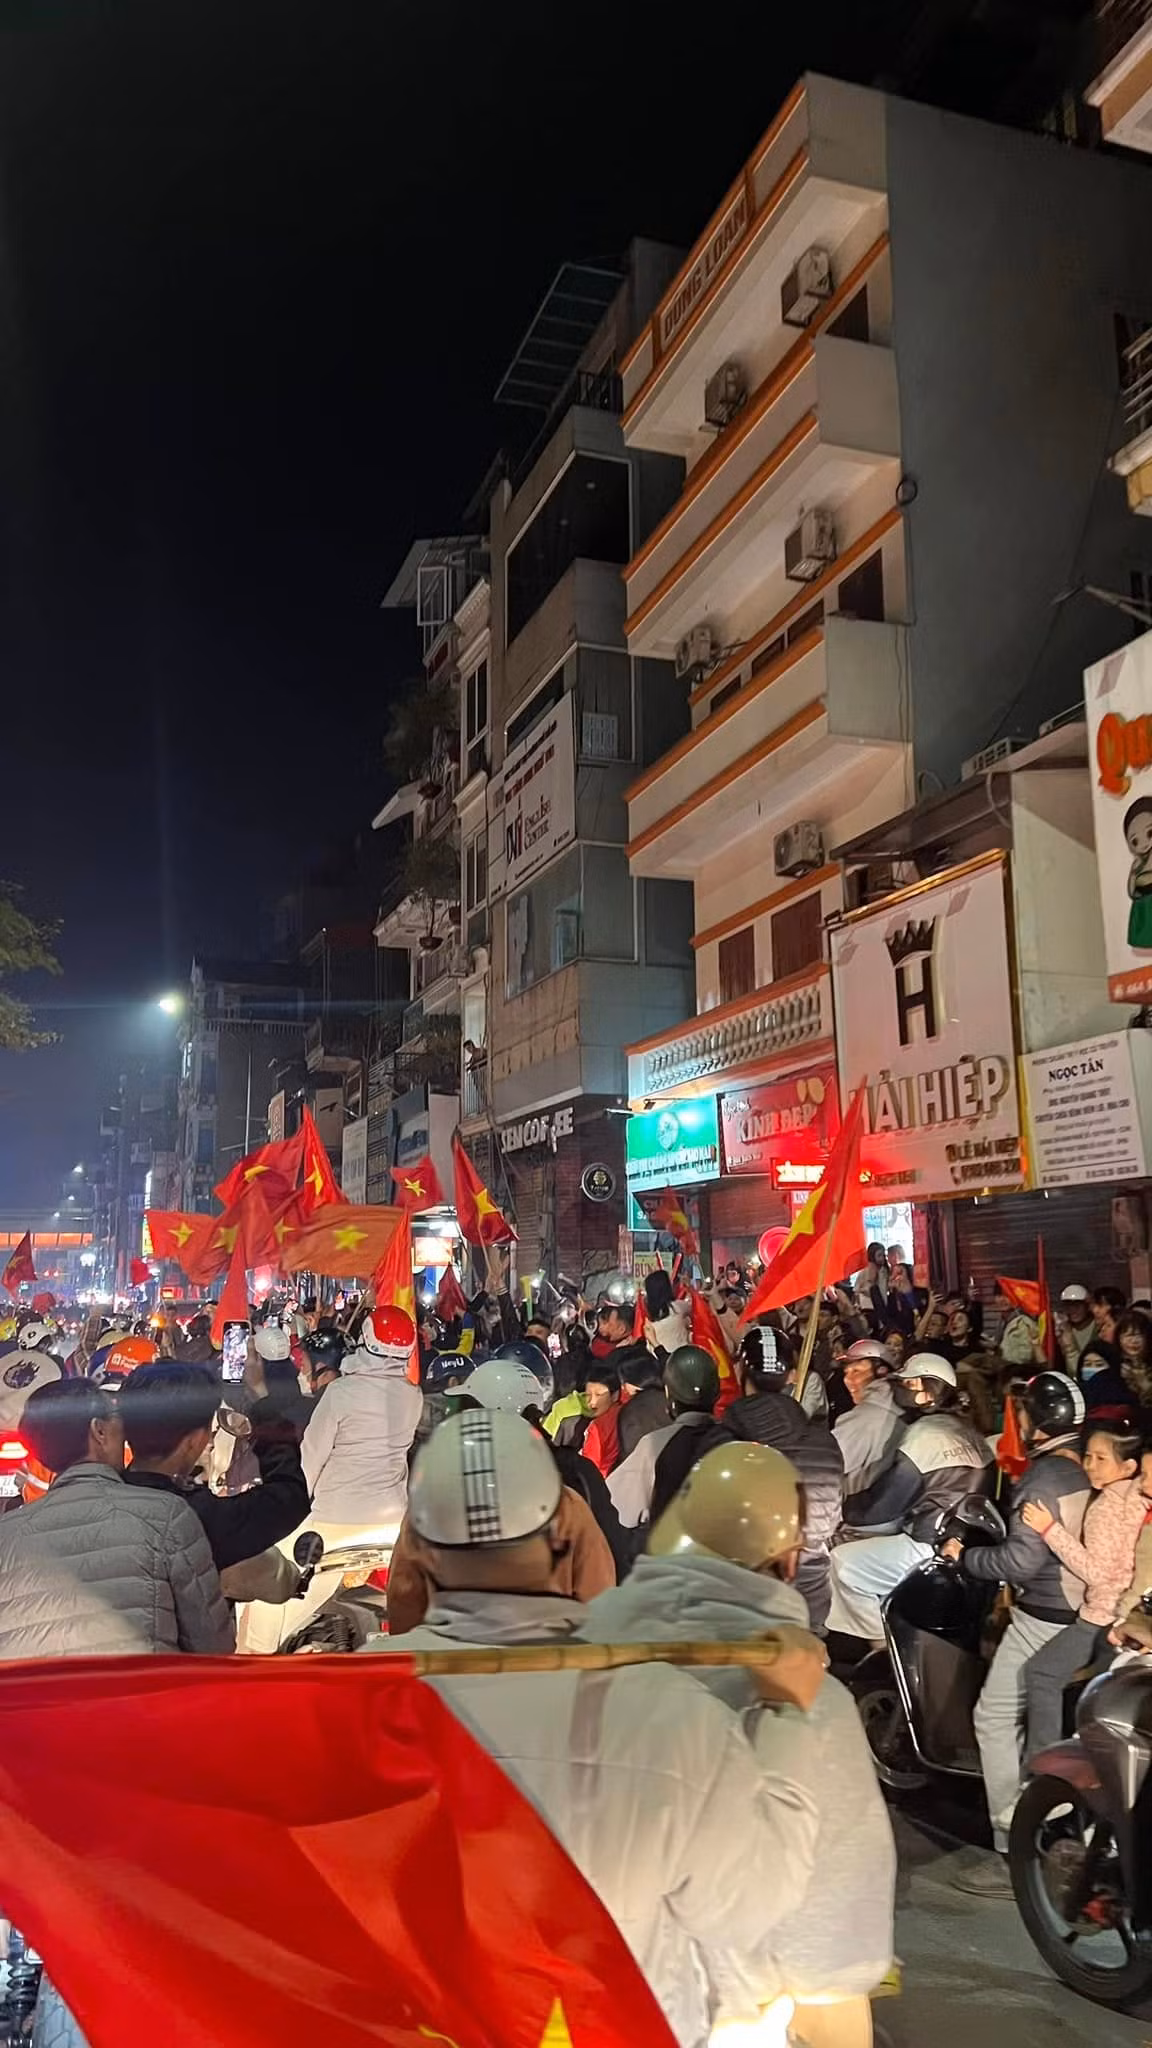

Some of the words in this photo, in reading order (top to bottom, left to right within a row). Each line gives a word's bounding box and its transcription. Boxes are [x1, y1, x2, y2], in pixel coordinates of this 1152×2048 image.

[917, 1054, 1007, 1128] HIỆP
[1049, 1064, 1079, 1082] NGỌC
[523, 1106, 574, 1148] COFEE
